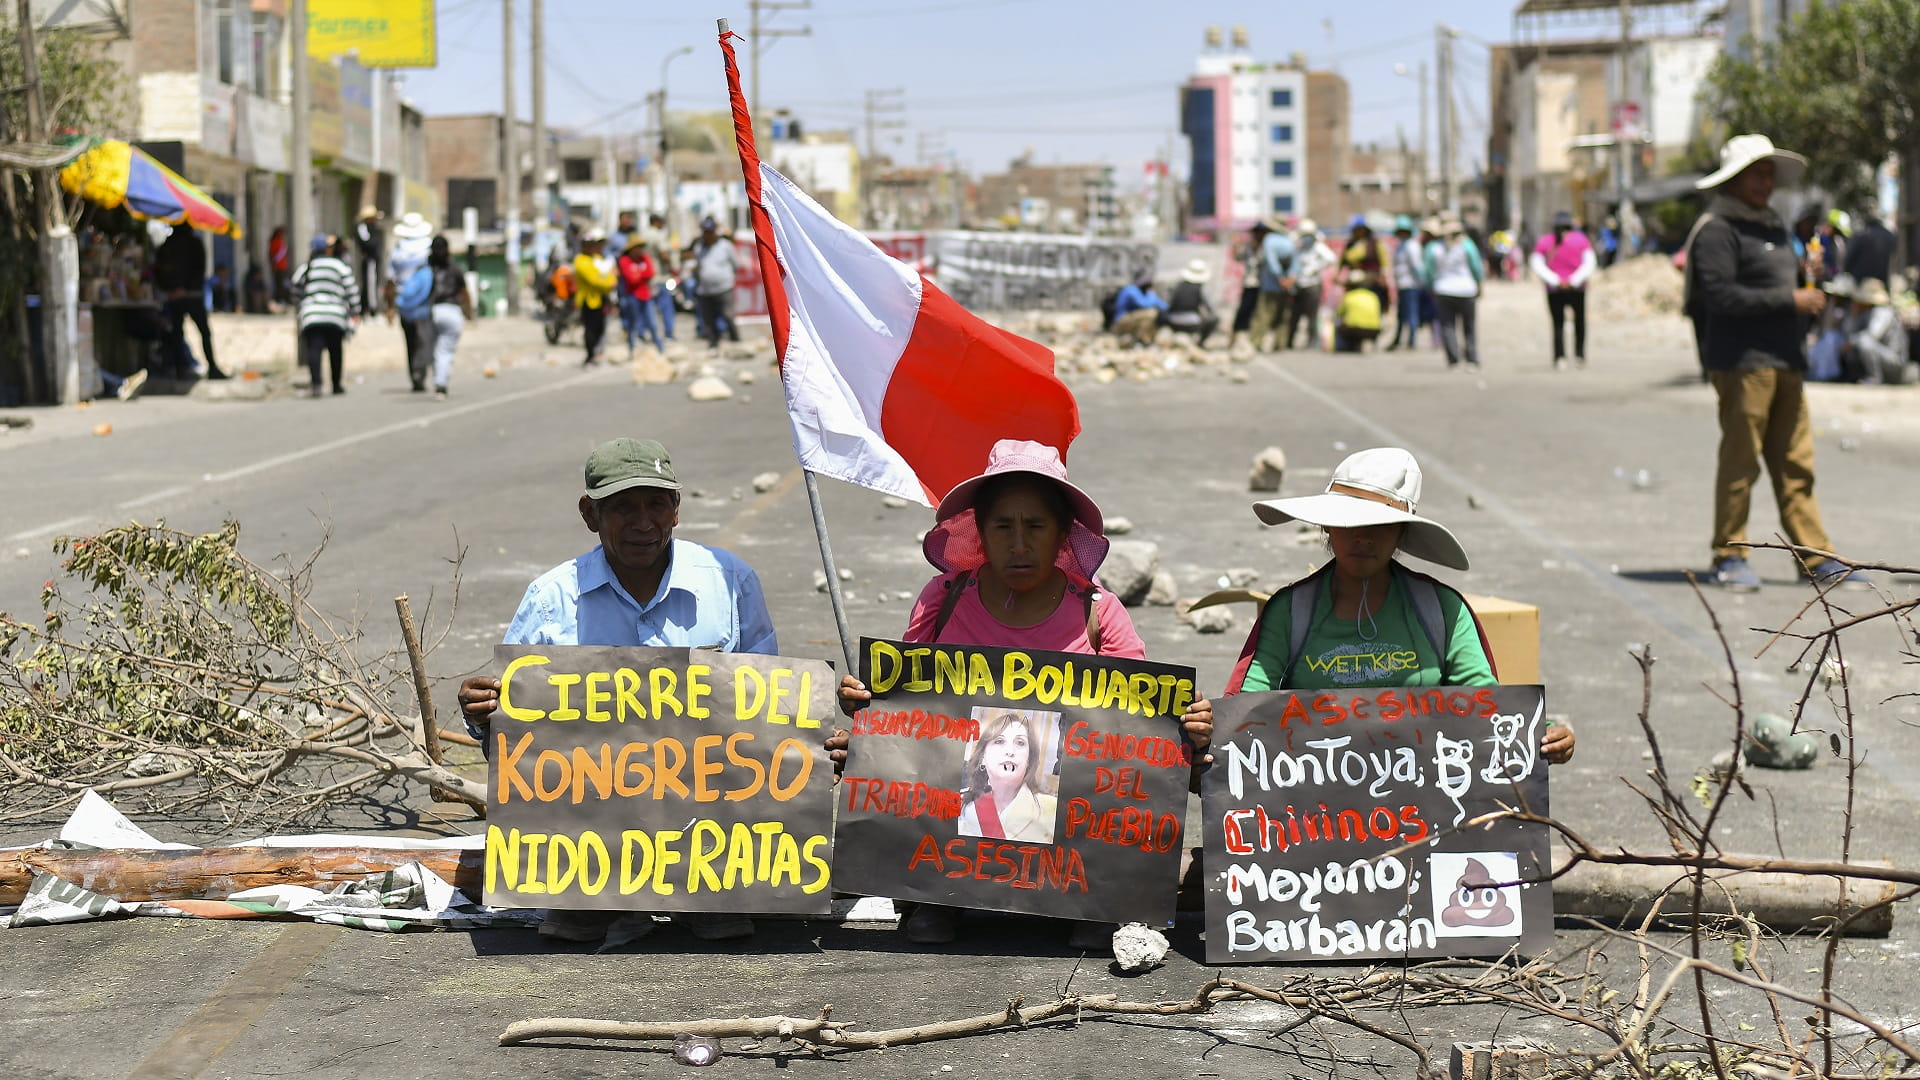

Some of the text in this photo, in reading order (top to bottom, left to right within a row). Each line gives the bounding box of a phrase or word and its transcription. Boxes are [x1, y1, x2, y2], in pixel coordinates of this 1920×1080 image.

[499, 654, 821, 729] CIERRE DEL
[869, 640, 1195, 719] DINA BOLUARTE
[496, 731, 814, 805] KONGRESO
[843, 775, 963, 822] TRAIDORA
[1094, 766, 1150, 801] DEL
[485, 818, 831, 896] NIDO DE RATAS
[1064, 796, 1180, 853] PUEBLO
[907, 833, 1089, 894] ASESINA
